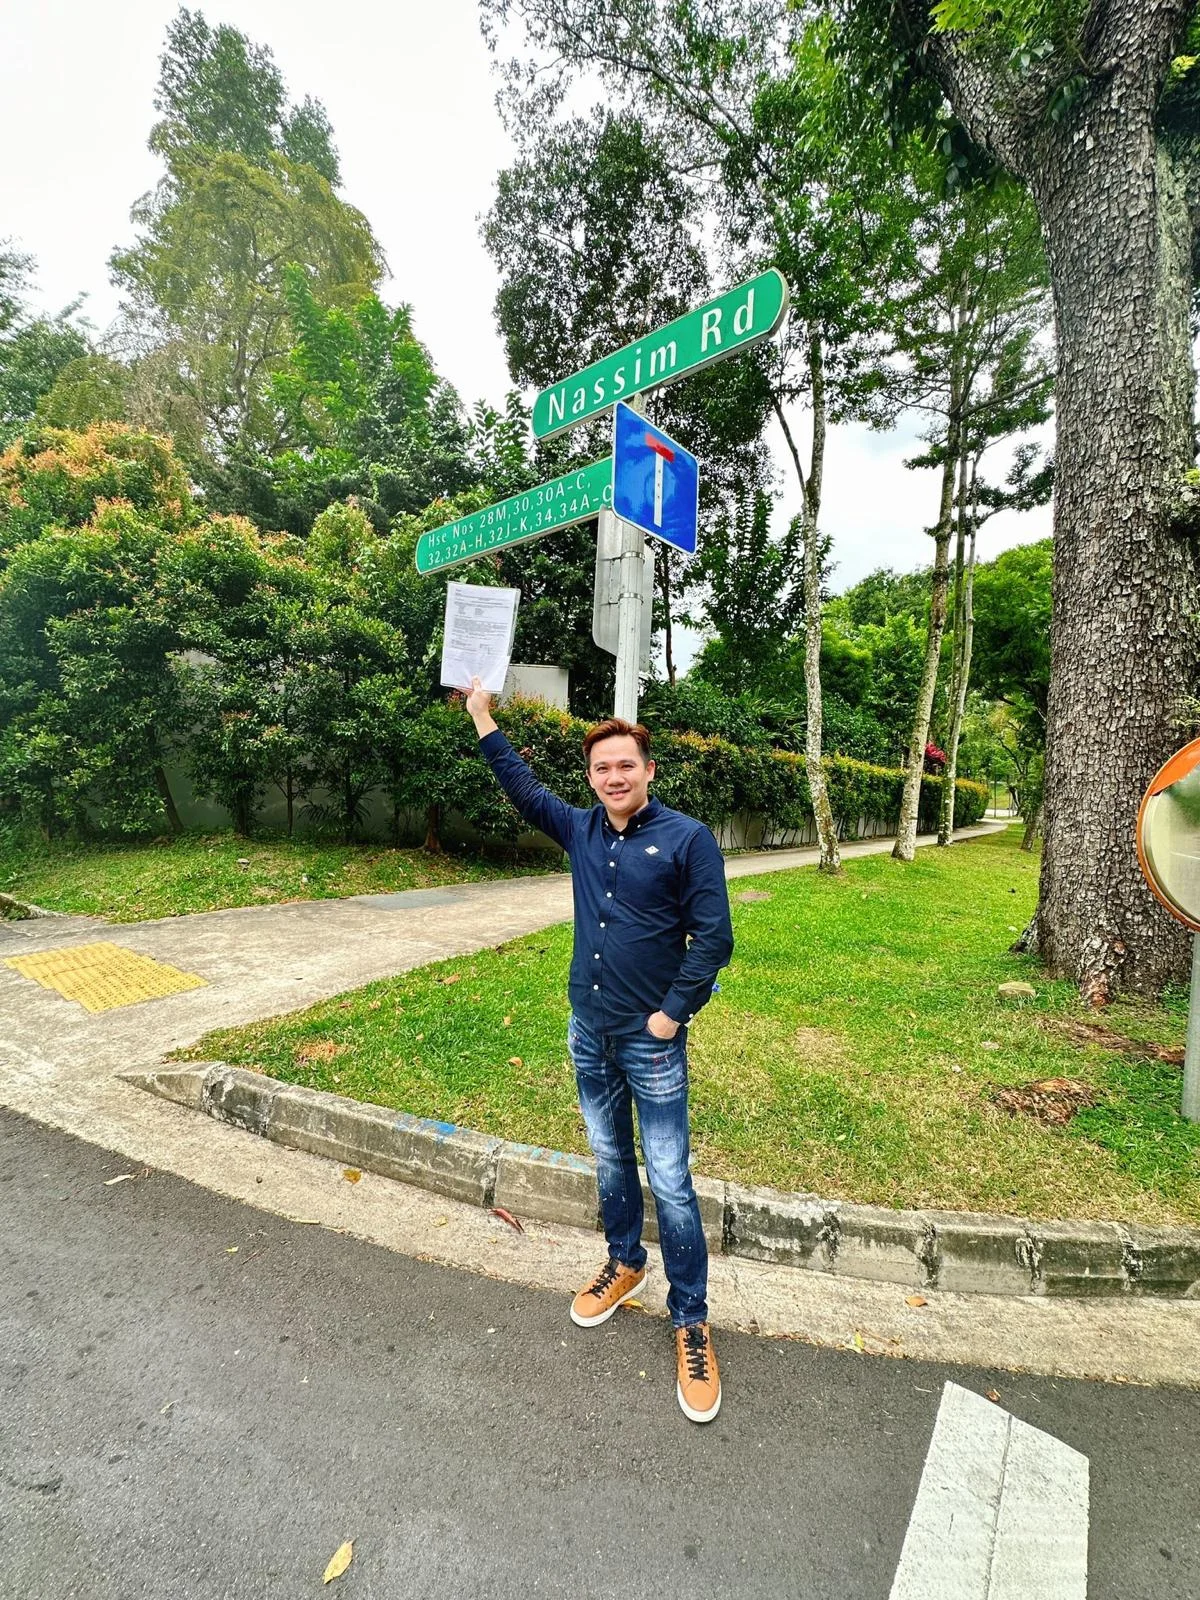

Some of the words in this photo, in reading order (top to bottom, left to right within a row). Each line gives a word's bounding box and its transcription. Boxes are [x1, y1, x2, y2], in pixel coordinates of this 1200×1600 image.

[547, 339, 677, 426] Nassim
[701, 288, 757, 353] Rd
[428, 534, 447, 549] Hse
[452, 524, 474, 538] Nos
